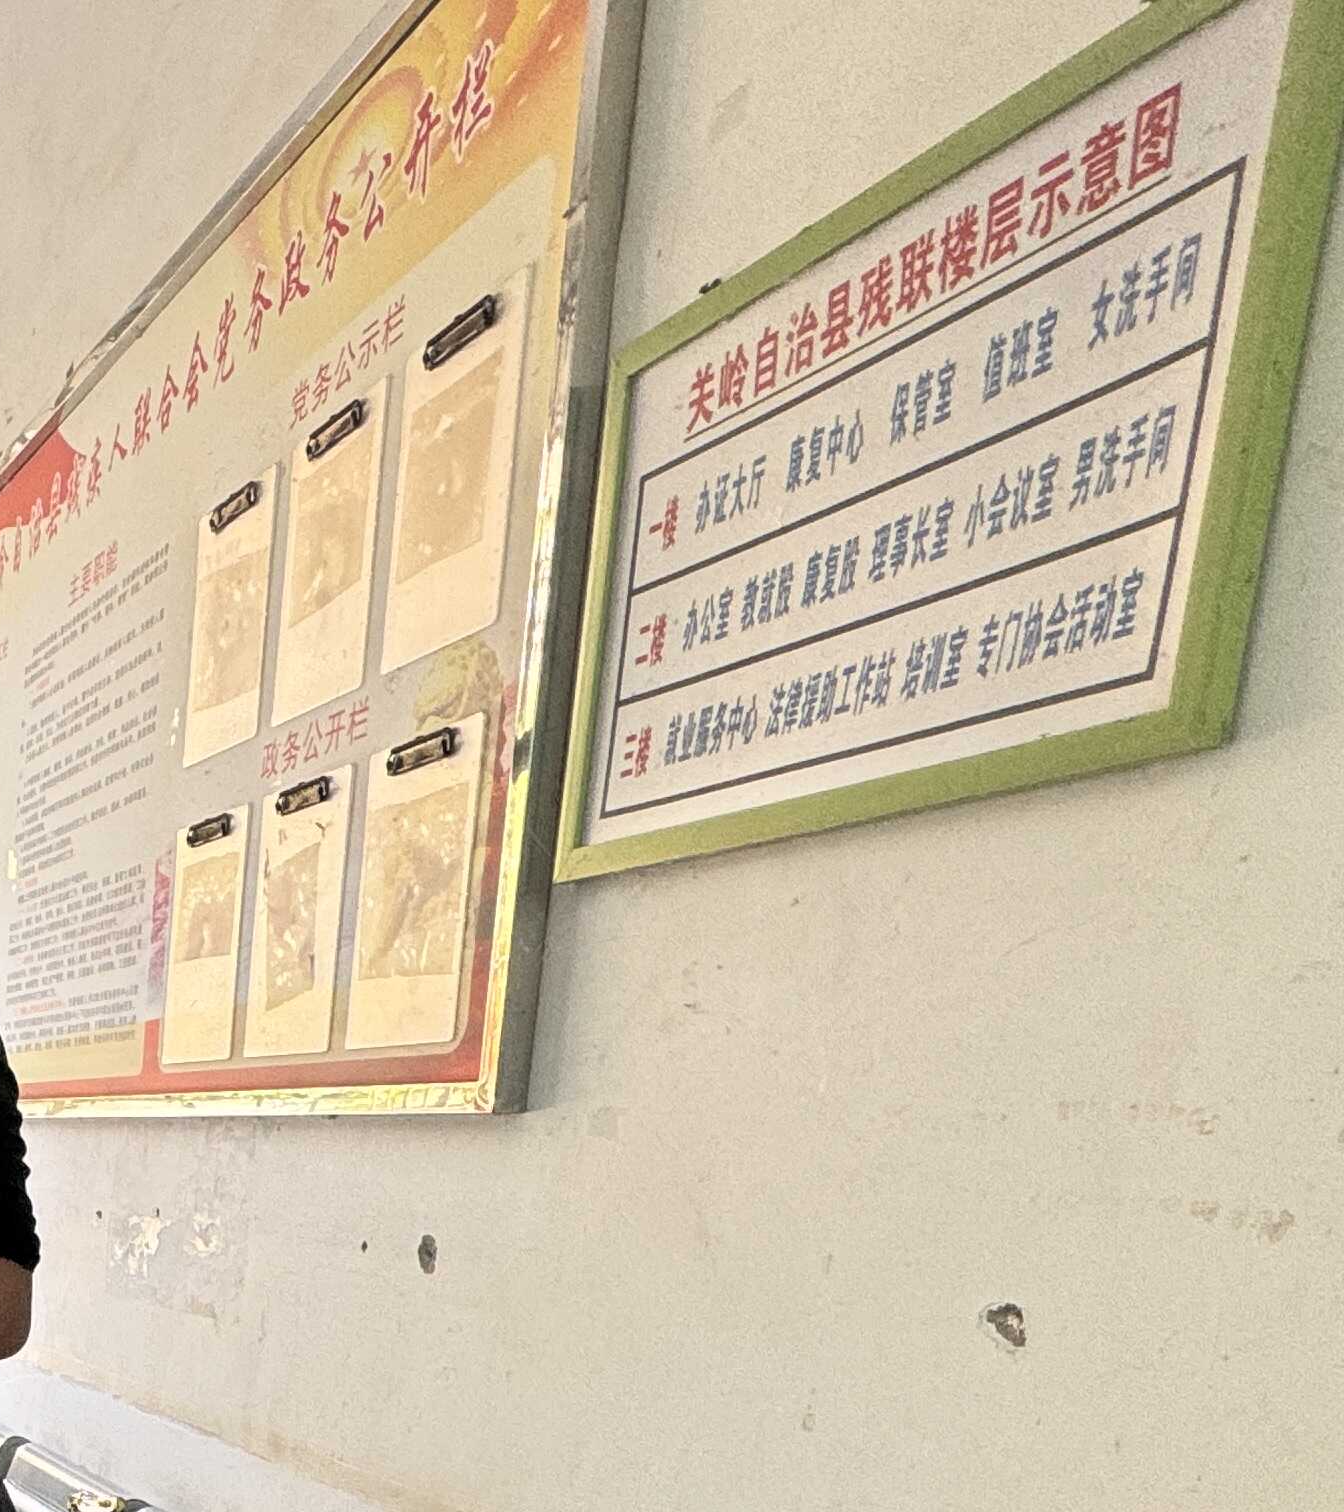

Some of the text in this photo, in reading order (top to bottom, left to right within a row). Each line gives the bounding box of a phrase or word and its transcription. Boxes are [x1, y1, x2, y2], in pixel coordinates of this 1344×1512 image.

[290, 293, 406, 430] 党务公示栏
[687, 82, 1183, 433] 关岭自治县残联楼层示意图
[649, 232, 1202, 551] 一楼 办证大厅 康复中心 保管室 值班室 女洗手间
[635, 405, 1177, 668] 二楼 办公室 教就股 康复股 理事长室 小会议室 男洗手间
[261, 695, 369, 778] 政务公开栏
[620, 566, 1145, 779] 三楼 就业服务中心 法律援助工作站 培训室 专门协会活动室
